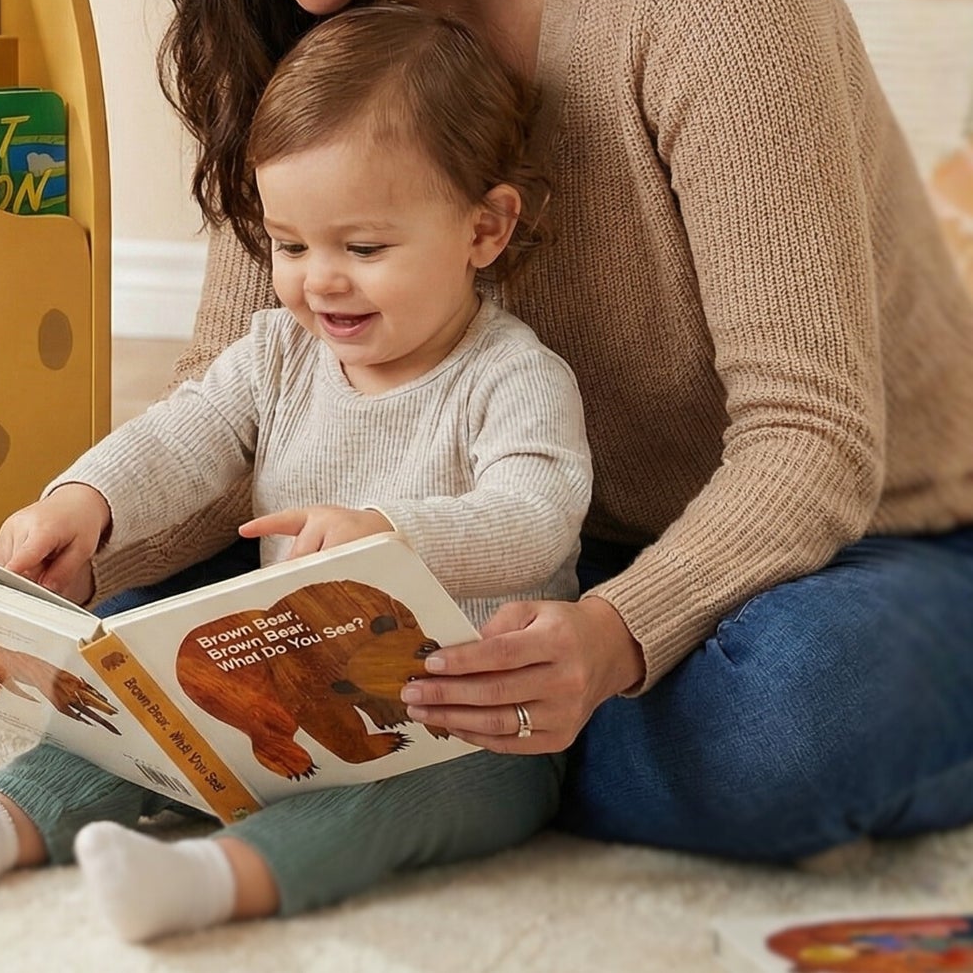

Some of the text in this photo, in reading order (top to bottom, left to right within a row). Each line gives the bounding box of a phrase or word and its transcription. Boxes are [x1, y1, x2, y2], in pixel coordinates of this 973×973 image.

[196, 610, 300, 649] Brown Bear,
[207, 622, 311, 661] Brown Bear,
[216, 617, 364, 673] What Do You See?
